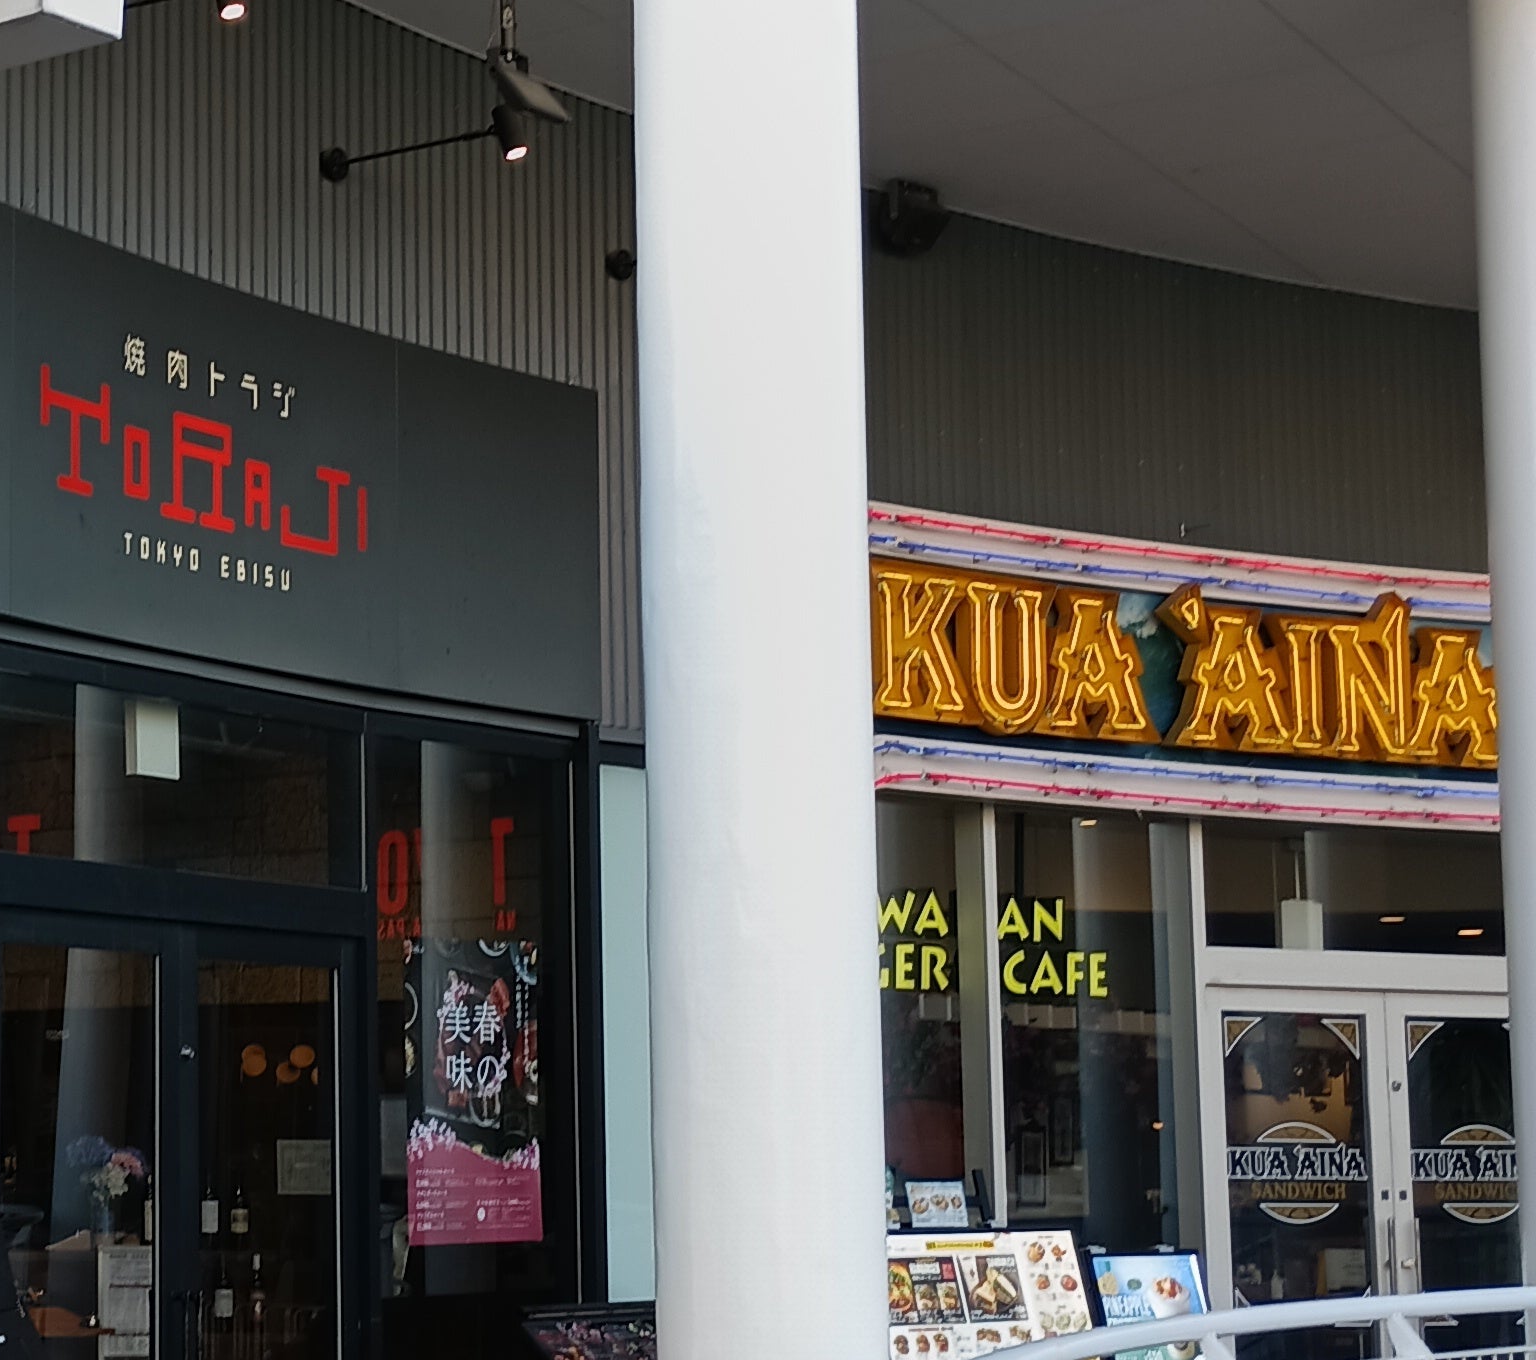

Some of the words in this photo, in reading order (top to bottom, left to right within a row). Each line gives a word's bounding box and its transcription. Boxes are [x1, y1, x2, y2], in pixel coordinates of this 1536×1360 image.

[124, 333, 296, 418] 焼肉トラジ
[40, 363, 368, 556] TORAJI
[124, 532, 199, 572] TOKYO
[220, 555, 291, 591] EBISU
[868, 558, 1163, 745] KUA
[1003, 949, 1108, 997] CAFE
[1226, 1146, 1292, 1181] KUA
[1411, 1148, 1475, 1181] KUA
[1250, 1181, 1347, 1201] SANDWICH
[1434, 1182, 1517, 1200] SANDWIC
